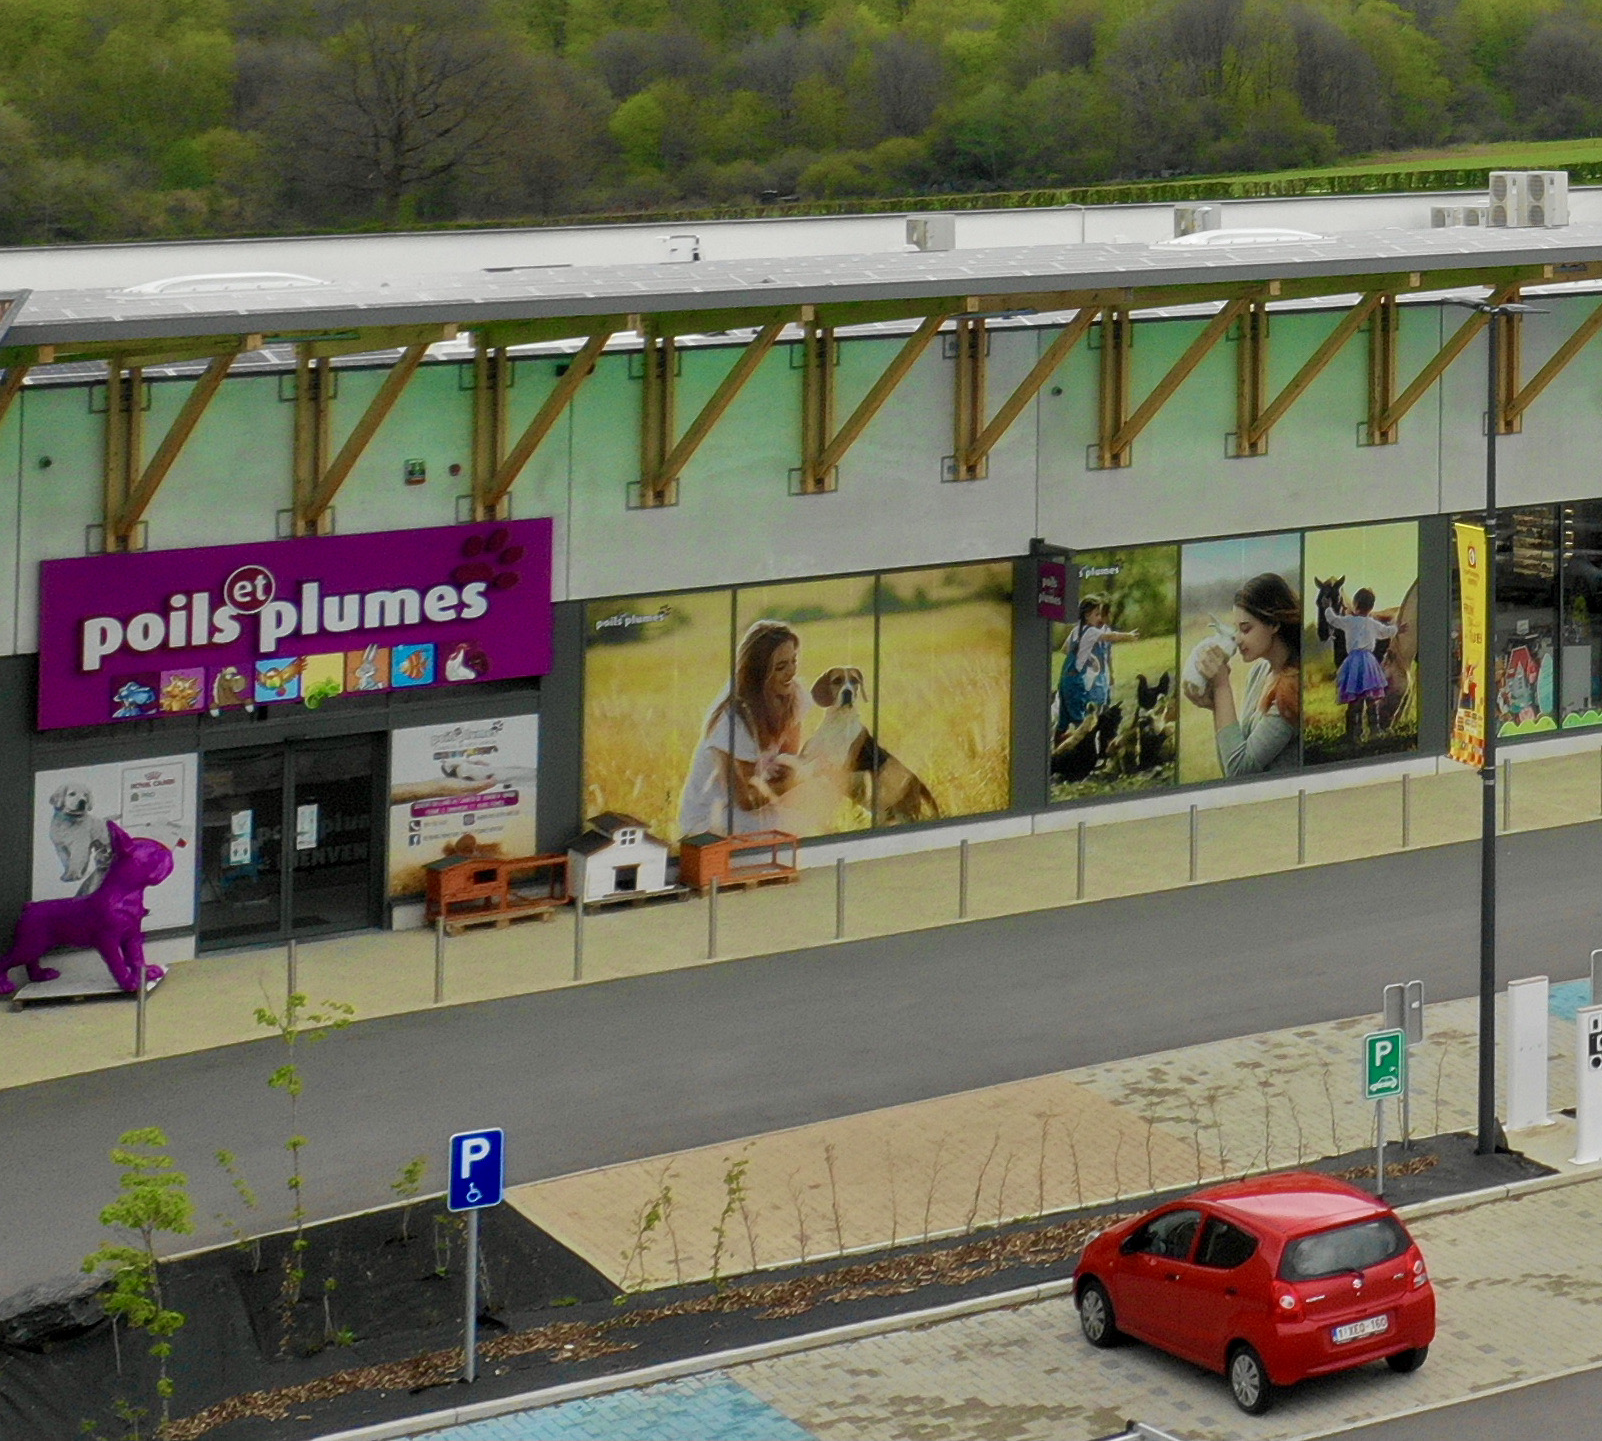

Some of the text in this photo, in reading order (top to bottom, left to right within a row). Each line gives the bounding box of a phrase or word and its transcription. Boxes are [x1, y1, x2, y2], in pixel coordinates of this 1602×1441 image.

[82, 573, 489, 671] poils et plumes
[1375, 1040, 1392, 1067] P
[462, 1138, 490, 1179] P
